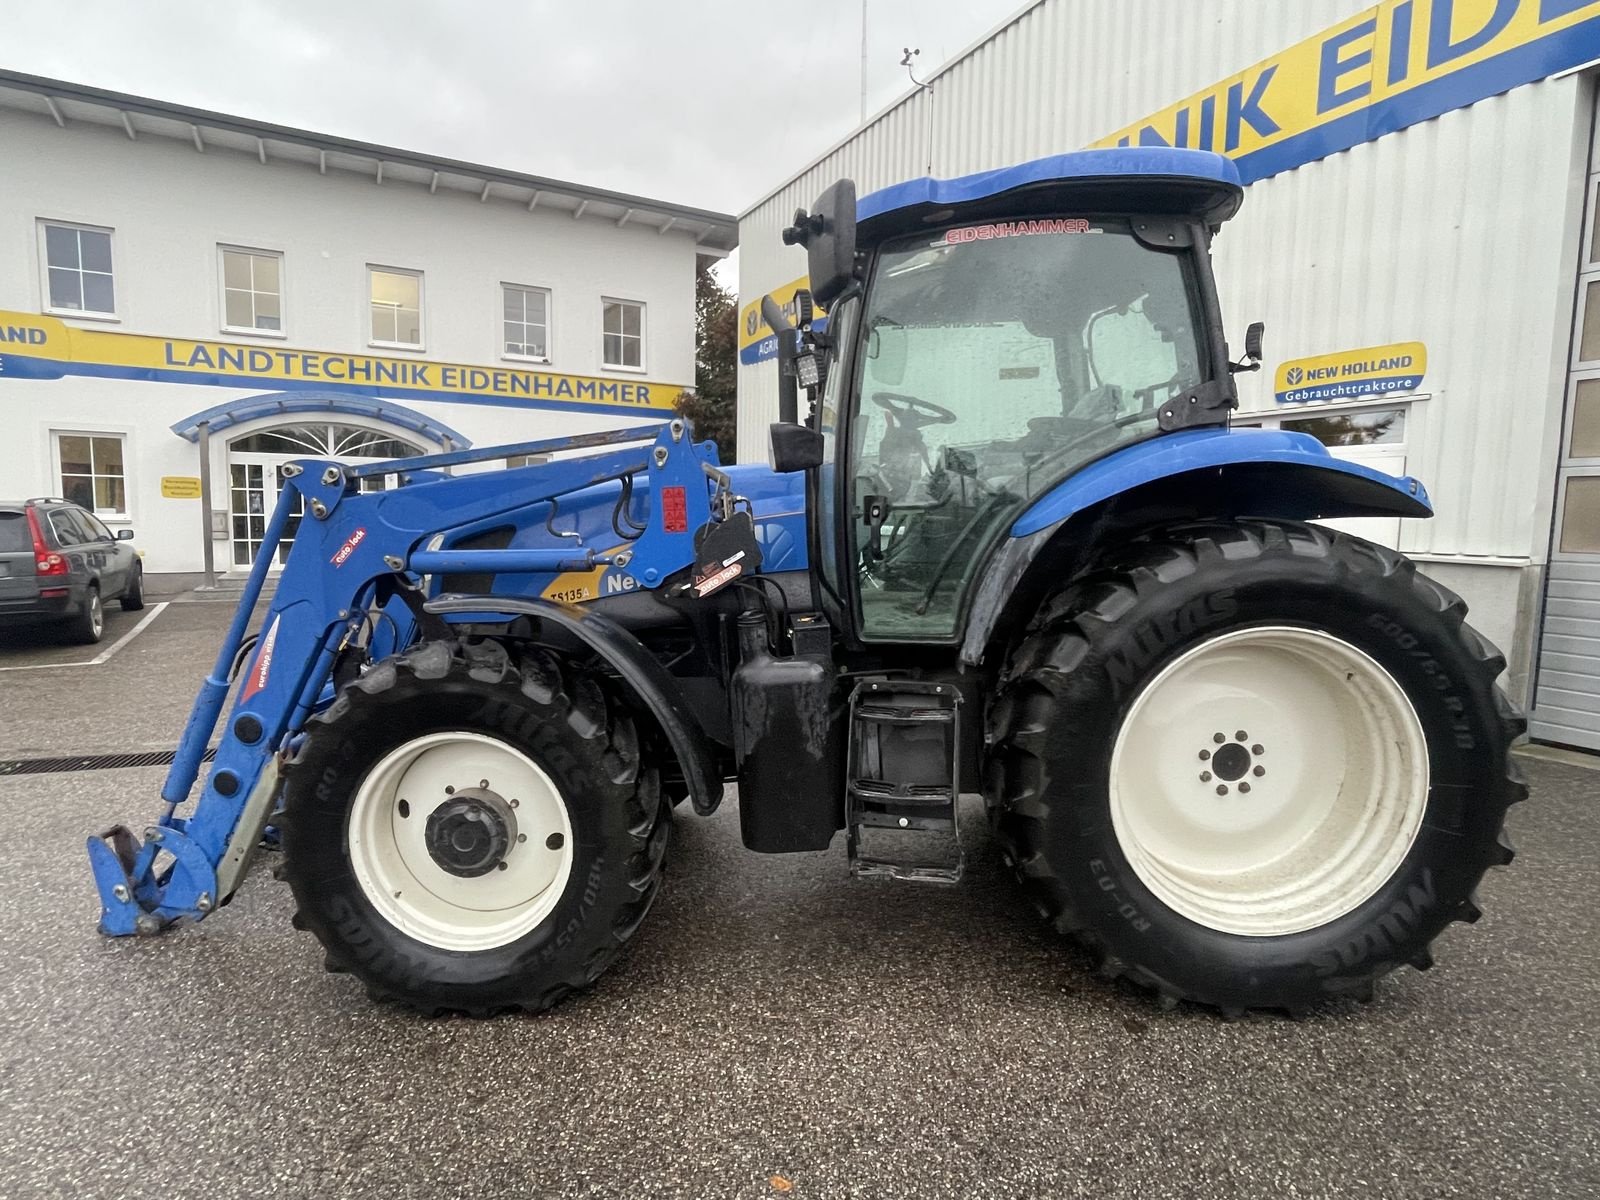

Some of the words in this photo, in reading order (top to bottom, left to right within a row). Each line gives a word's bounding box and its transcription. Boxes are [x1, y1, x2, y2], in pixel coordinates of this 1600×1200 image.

[946, 219, 1089, 244] EIDENHAMMER
[164, 342, 431, 386] LANDTECHNIK
[441, 367, 651, 405] EIDENHAMMER
[1306, 366, 1338, 381] NEW
[1341, 355, 1413, 376] HOLLAND
[1285, 379, 1413, 402] Gebrauchttraktore
[349, 530, 365, 546] lock
[607, 573, 641, 593] Ne
[721, 564, 738, 580] lock
